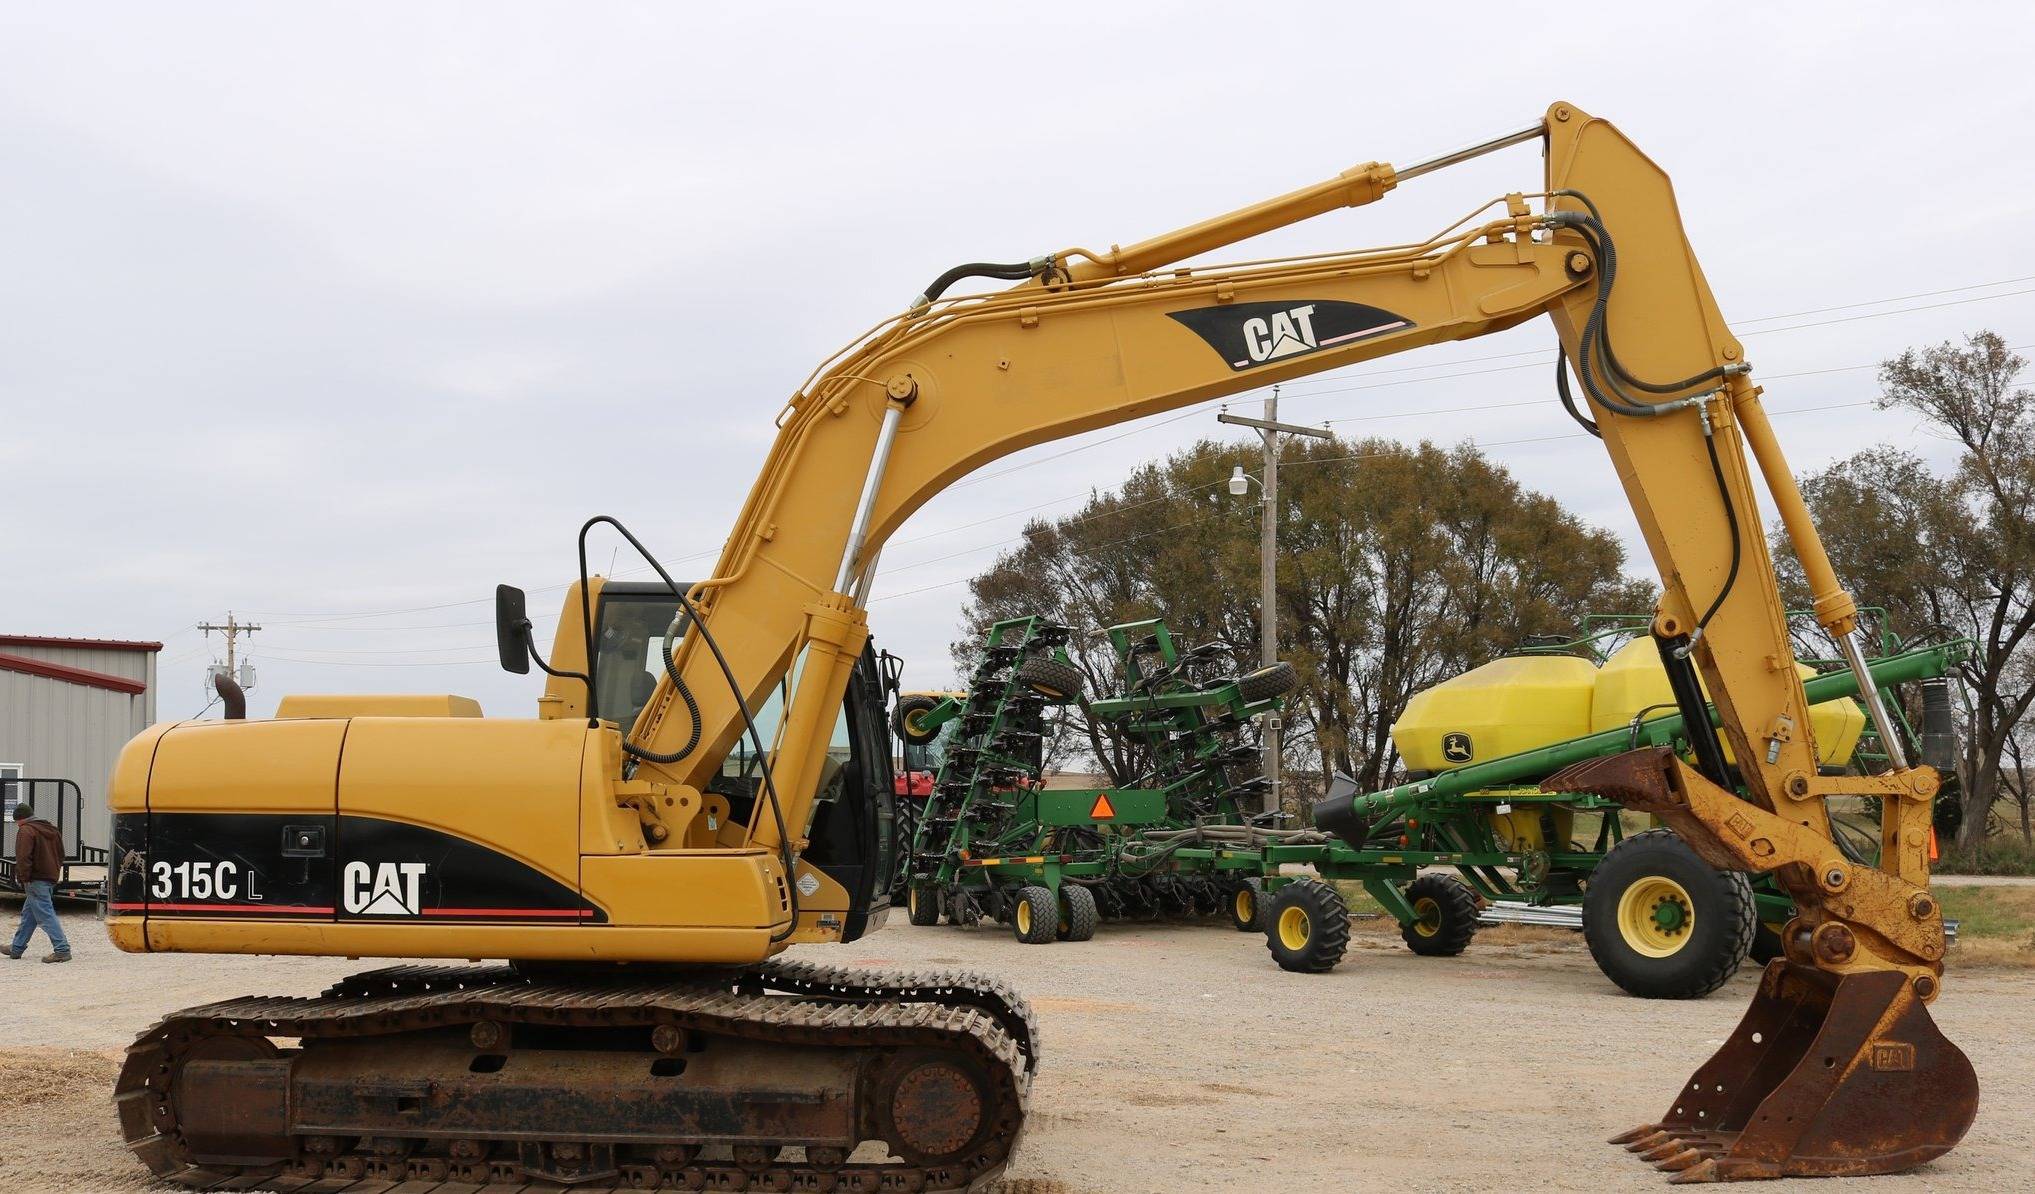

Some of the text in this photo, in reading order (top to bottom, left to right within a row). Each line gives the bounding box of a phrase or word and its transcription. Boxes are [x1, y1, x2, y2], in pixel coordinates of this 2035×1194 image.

[1243, 305, 1317, 362] CAT
[152, 861, 263, 900] 315C L
[343, 861, 427, 915] CAT
